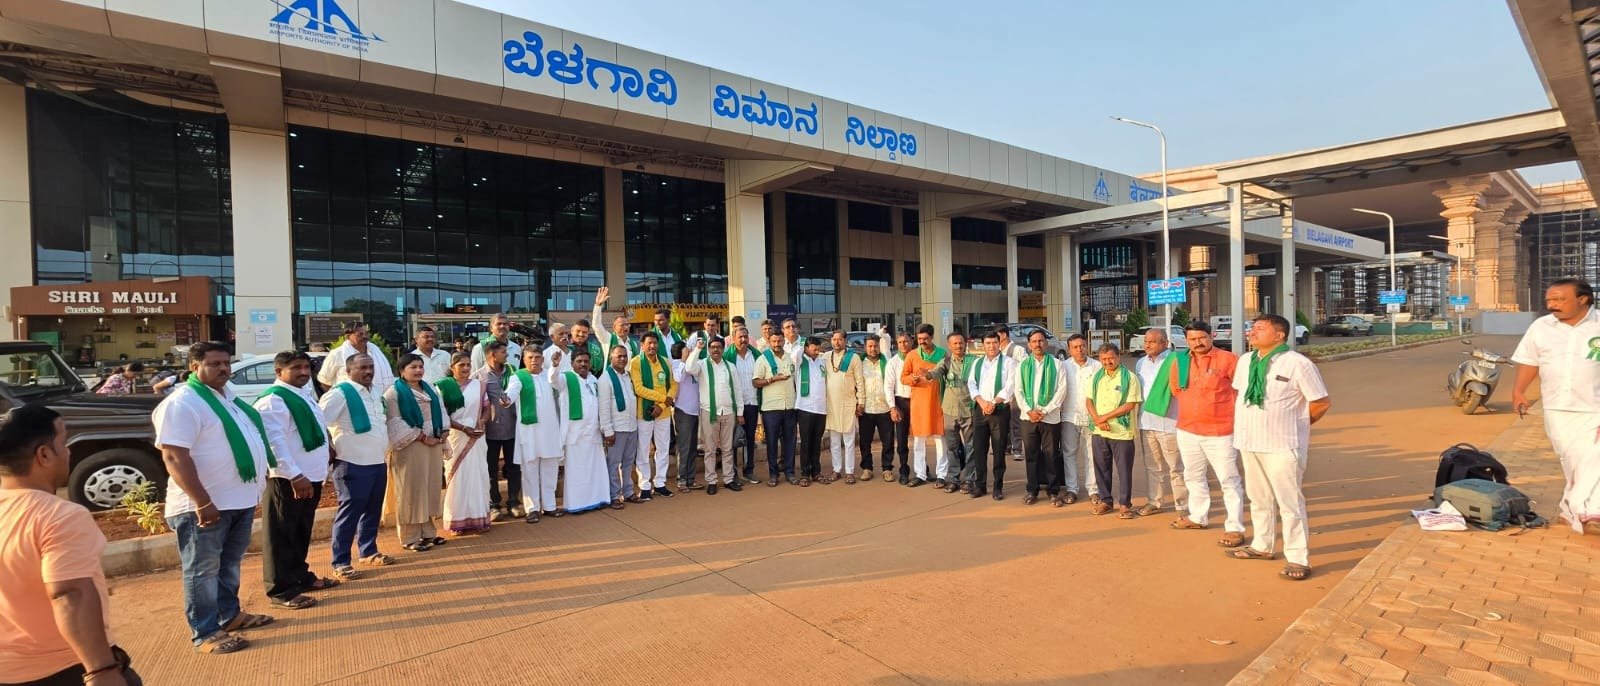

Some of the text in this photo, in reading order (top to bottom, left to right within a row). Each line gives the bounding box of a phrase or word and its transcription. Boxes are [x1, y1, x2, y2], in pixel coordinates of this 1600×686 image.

[269, 30, 302, 41] AIRPORTS
[304, 35, 340, 47] AUTHORITY
[352, 45, 369, 53] INDIA
[503, 31, 917, 160] ಬೆಳಗಾವಿ ವಿಮಾನ ನಿಲ್ದಾಣ
[1307, 228, 1354, 249] BELAGAVI AIRPORT
[48, 290, 177, 304] SHRI MAULI
[64, 305, 105, 314] Snacks
[112, 306, 131, 314] and
